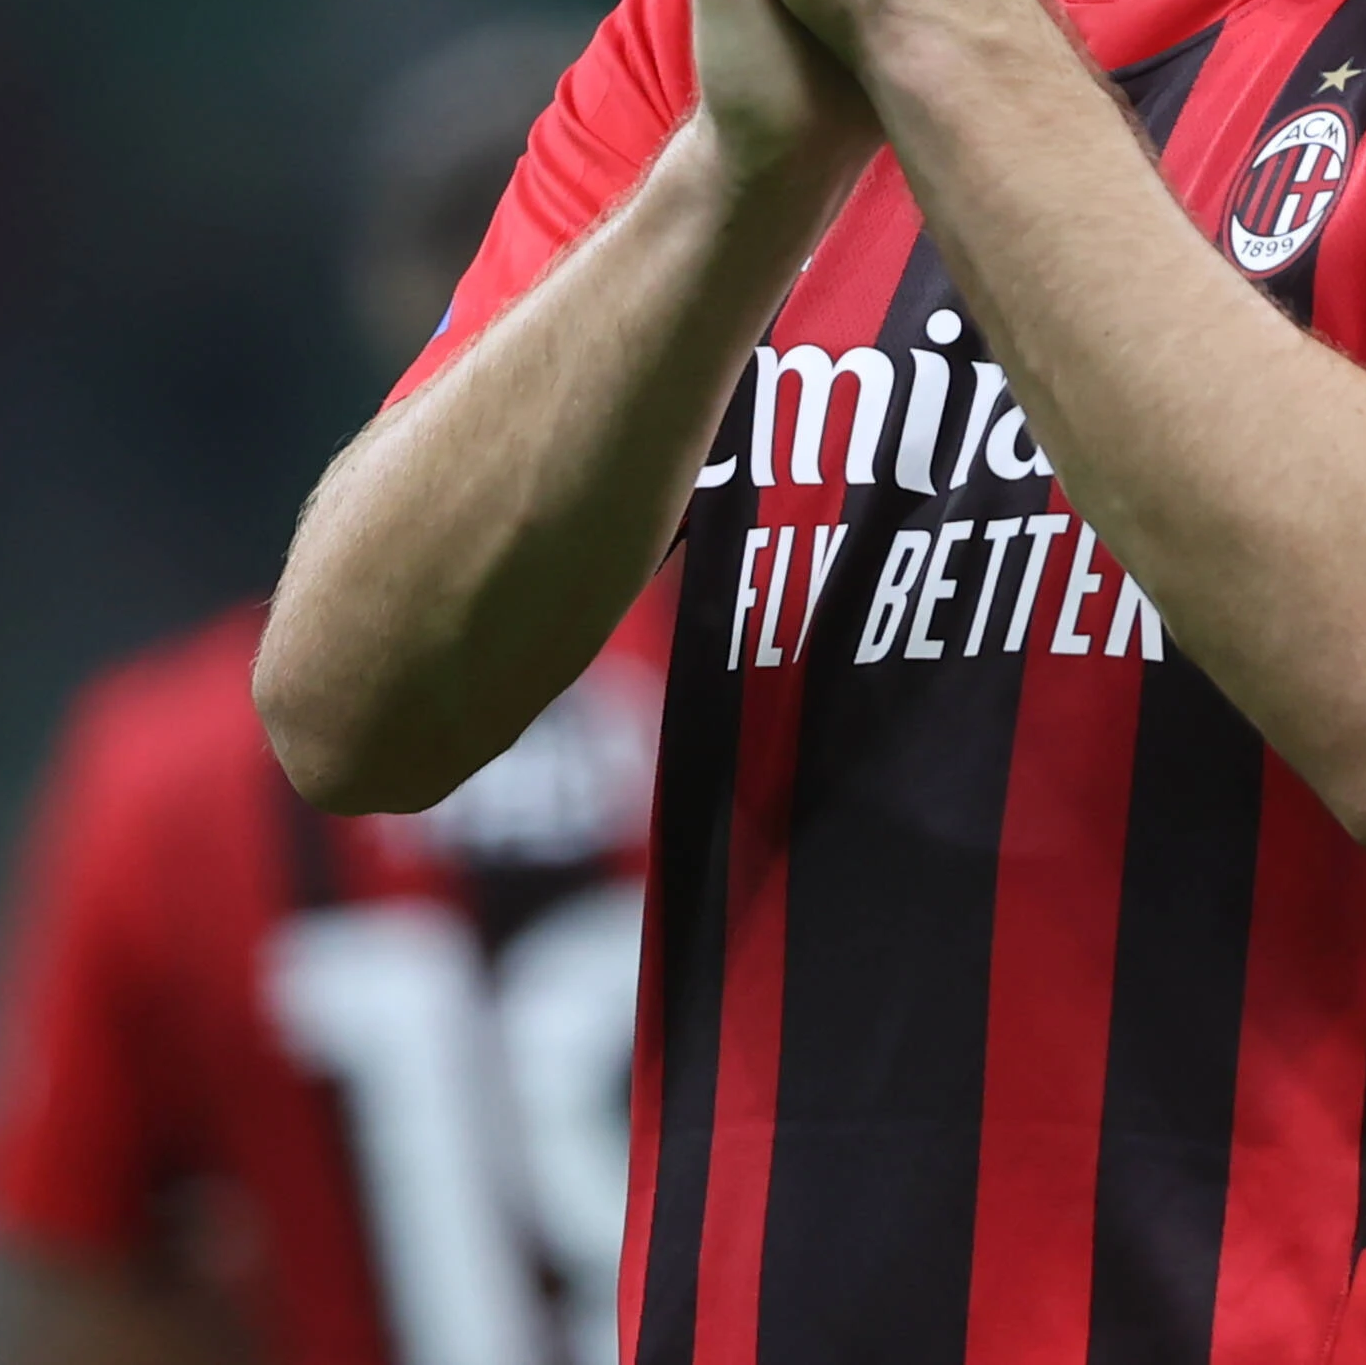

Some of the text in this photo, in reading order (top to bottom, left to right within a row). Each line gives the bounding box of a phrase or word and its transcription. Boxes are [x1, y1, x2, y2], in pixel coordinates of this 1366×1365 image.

[1278, 118, 1339, 148] ACM
[1241, 238, 1293, 257] 1899
[695, 308, 1055, 495] mira
[727, 524, 849, 671] FLY
